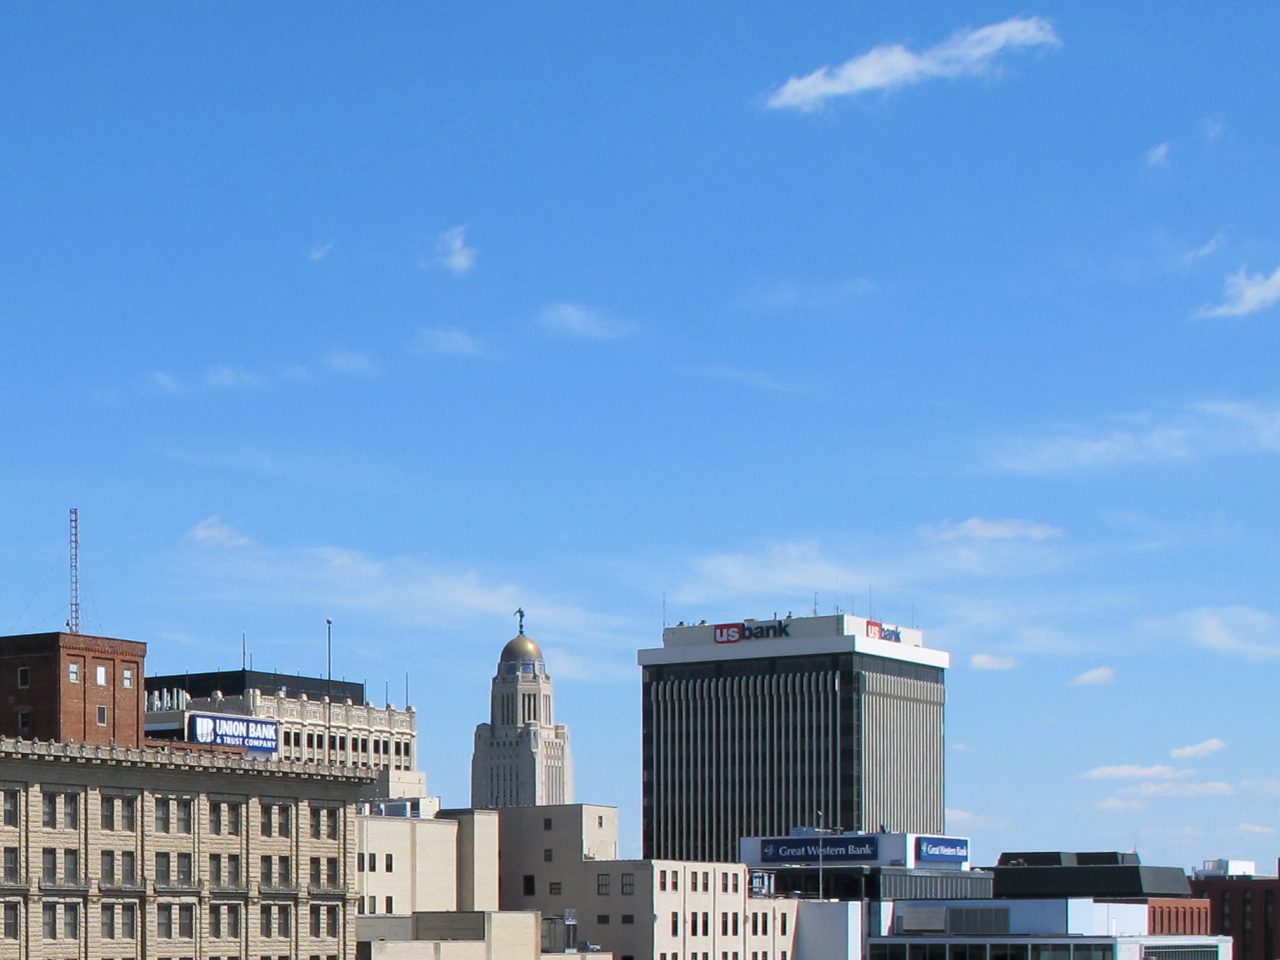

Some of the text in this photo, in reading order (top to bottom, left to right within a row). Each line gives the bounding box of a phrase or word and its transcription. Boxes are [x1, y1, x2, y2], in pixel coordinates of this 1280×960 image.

[216, 719, 276, 740] UNION BANK
[224, 736, 242, 746] TRUST
[244, 738, 277, 749] COMPANY
[778, 843, 872, 857] Great Western Bank
